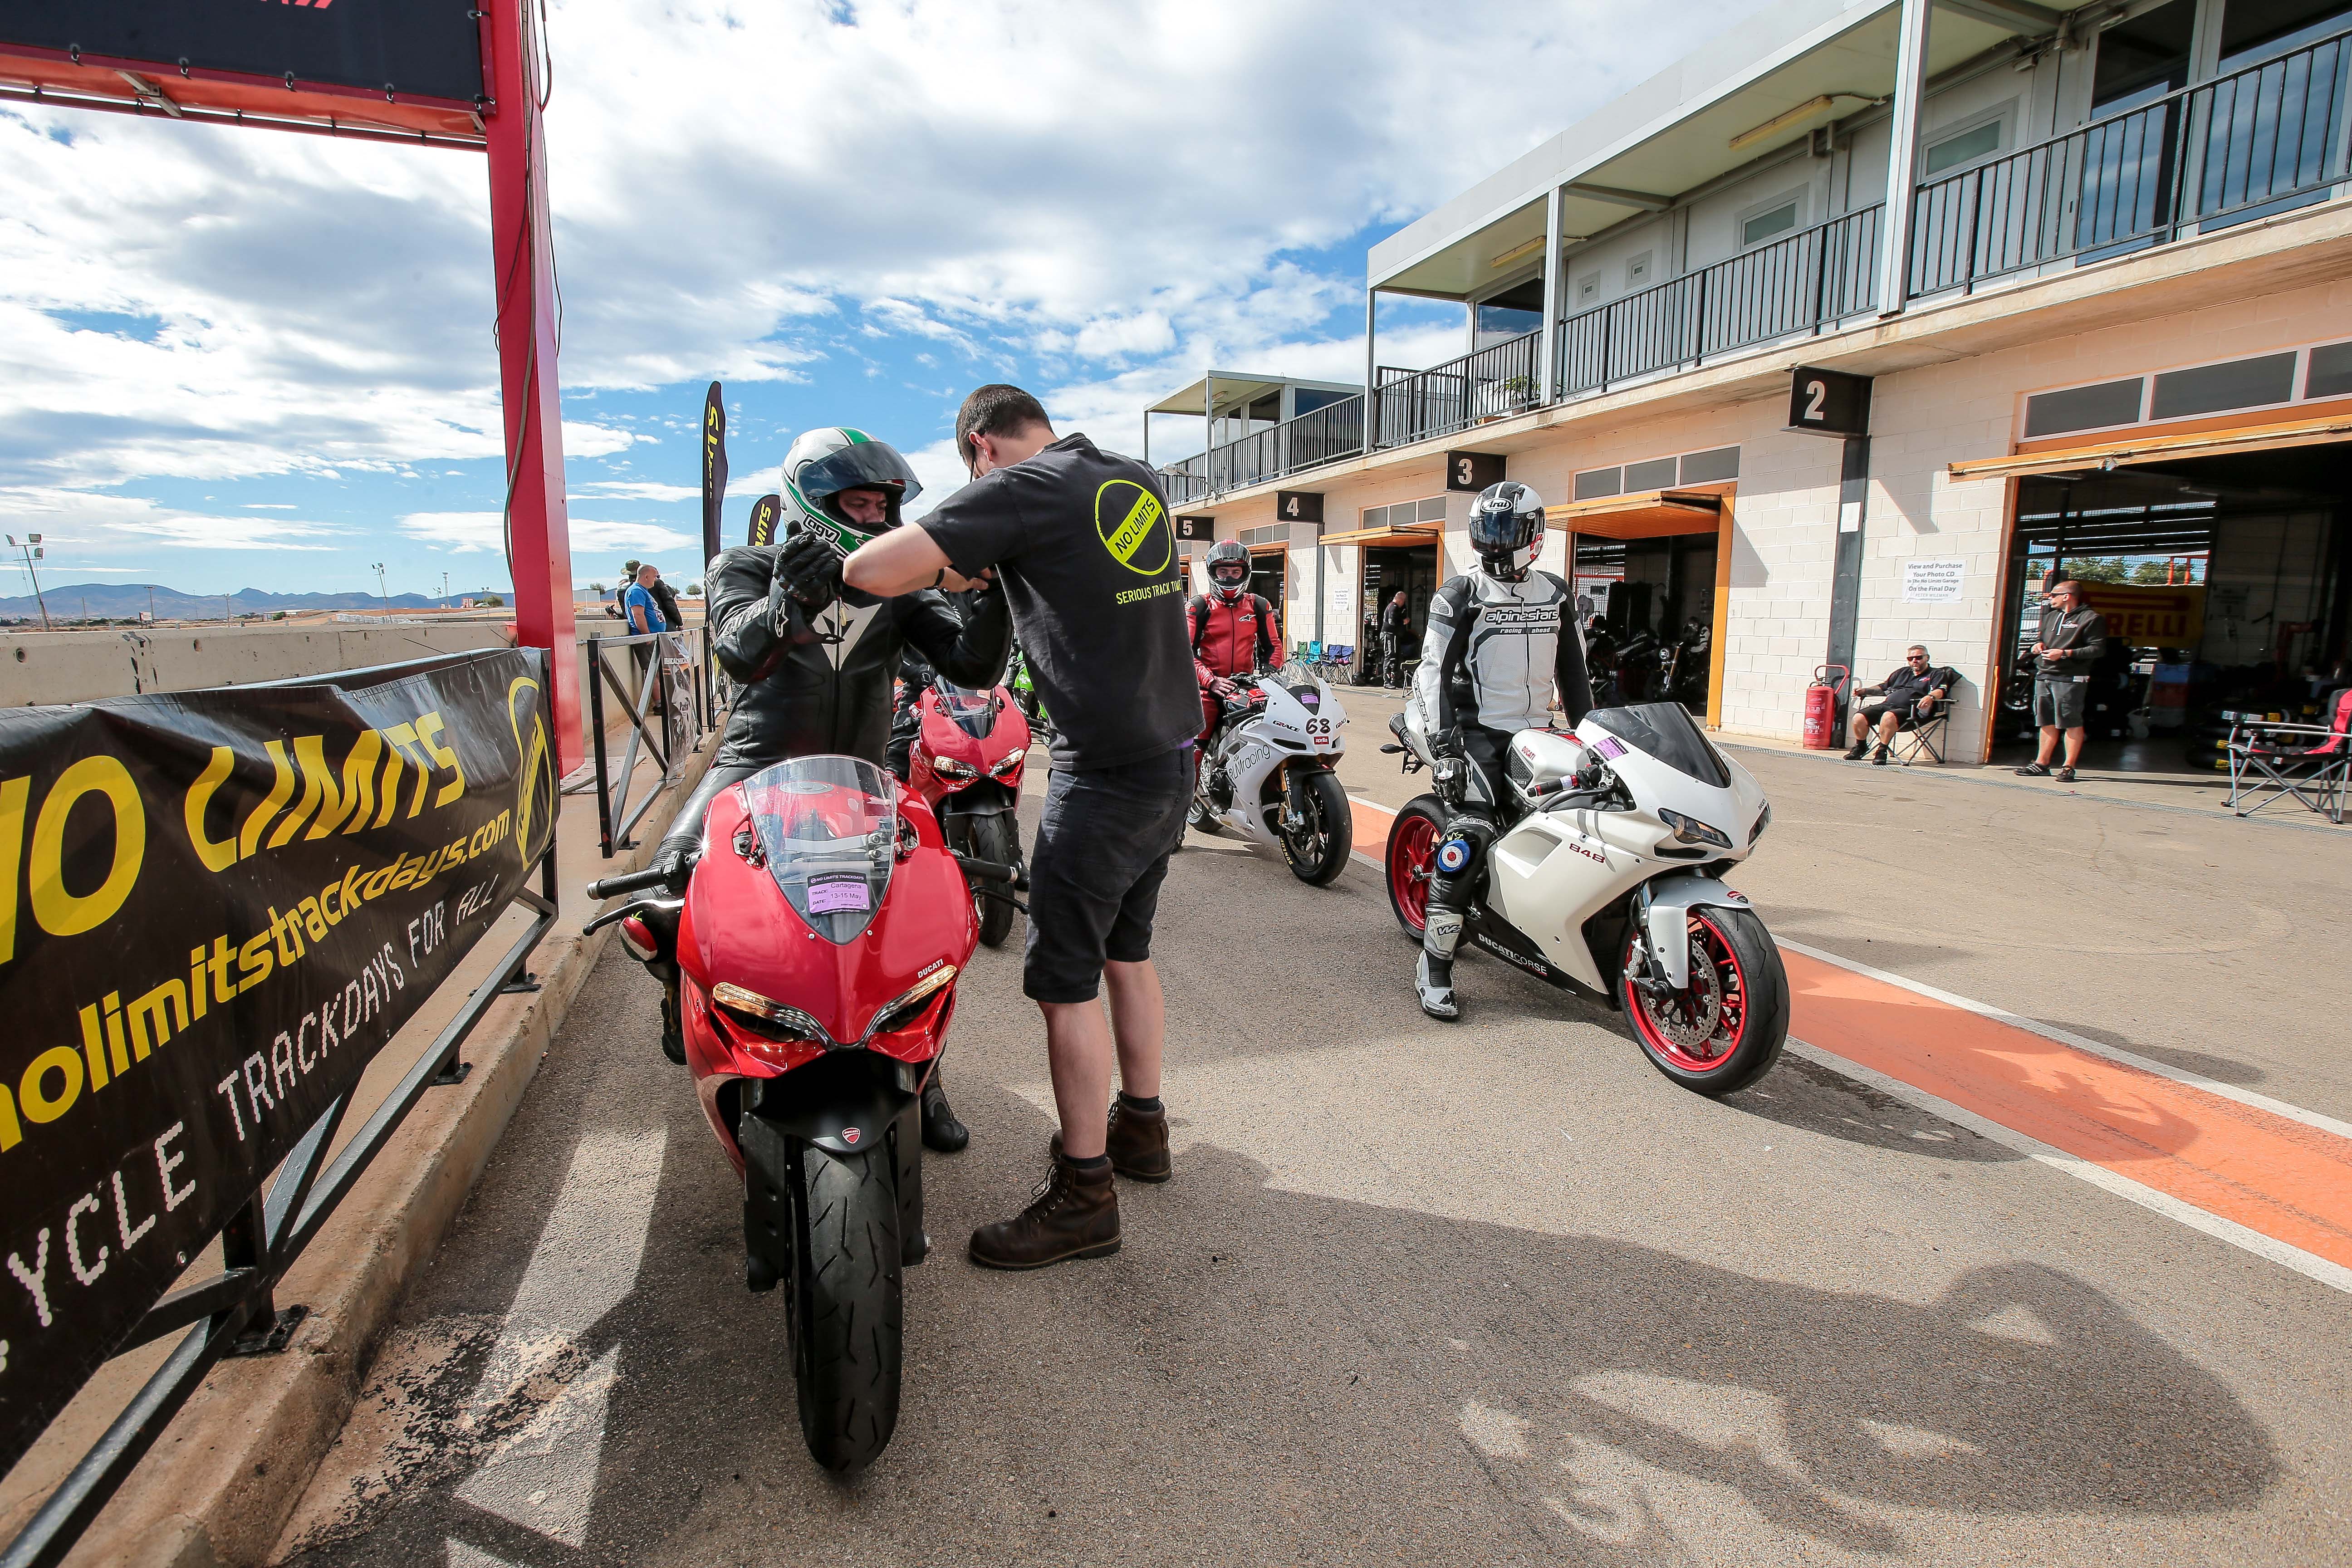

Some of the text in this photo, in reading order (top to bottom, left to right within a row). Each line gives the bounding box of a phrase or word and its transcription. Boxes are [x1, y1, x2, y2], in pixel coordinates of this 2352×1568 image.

[1804, 381, 1826, 421] 2
[1457, 458, 1473, 485] 3
[1286, 497, 1299, 516] 4
[1114, 498, 1156, 554] NO LIMITS
[1182, 519, 1193, 536] 5
[1116, 587, 1152, 604] SERIOUS
[1152, 582, 1171, 597] TRACK
[1486, 610, 1558, 623] alpinestars
[1273, 720, 1300, 733] GRACE
[1306, 718, 1331, 735] 68
[1521, 746, 1536, 761] DUCATI
[185, 711, 465, 872] LIMITS
[1569, 843, 1605, 863] 848
[917, 958, 944, 979] DUCATI
[0, 873, 500, 1371] YCLE TRACKDAYS FOR ALL
